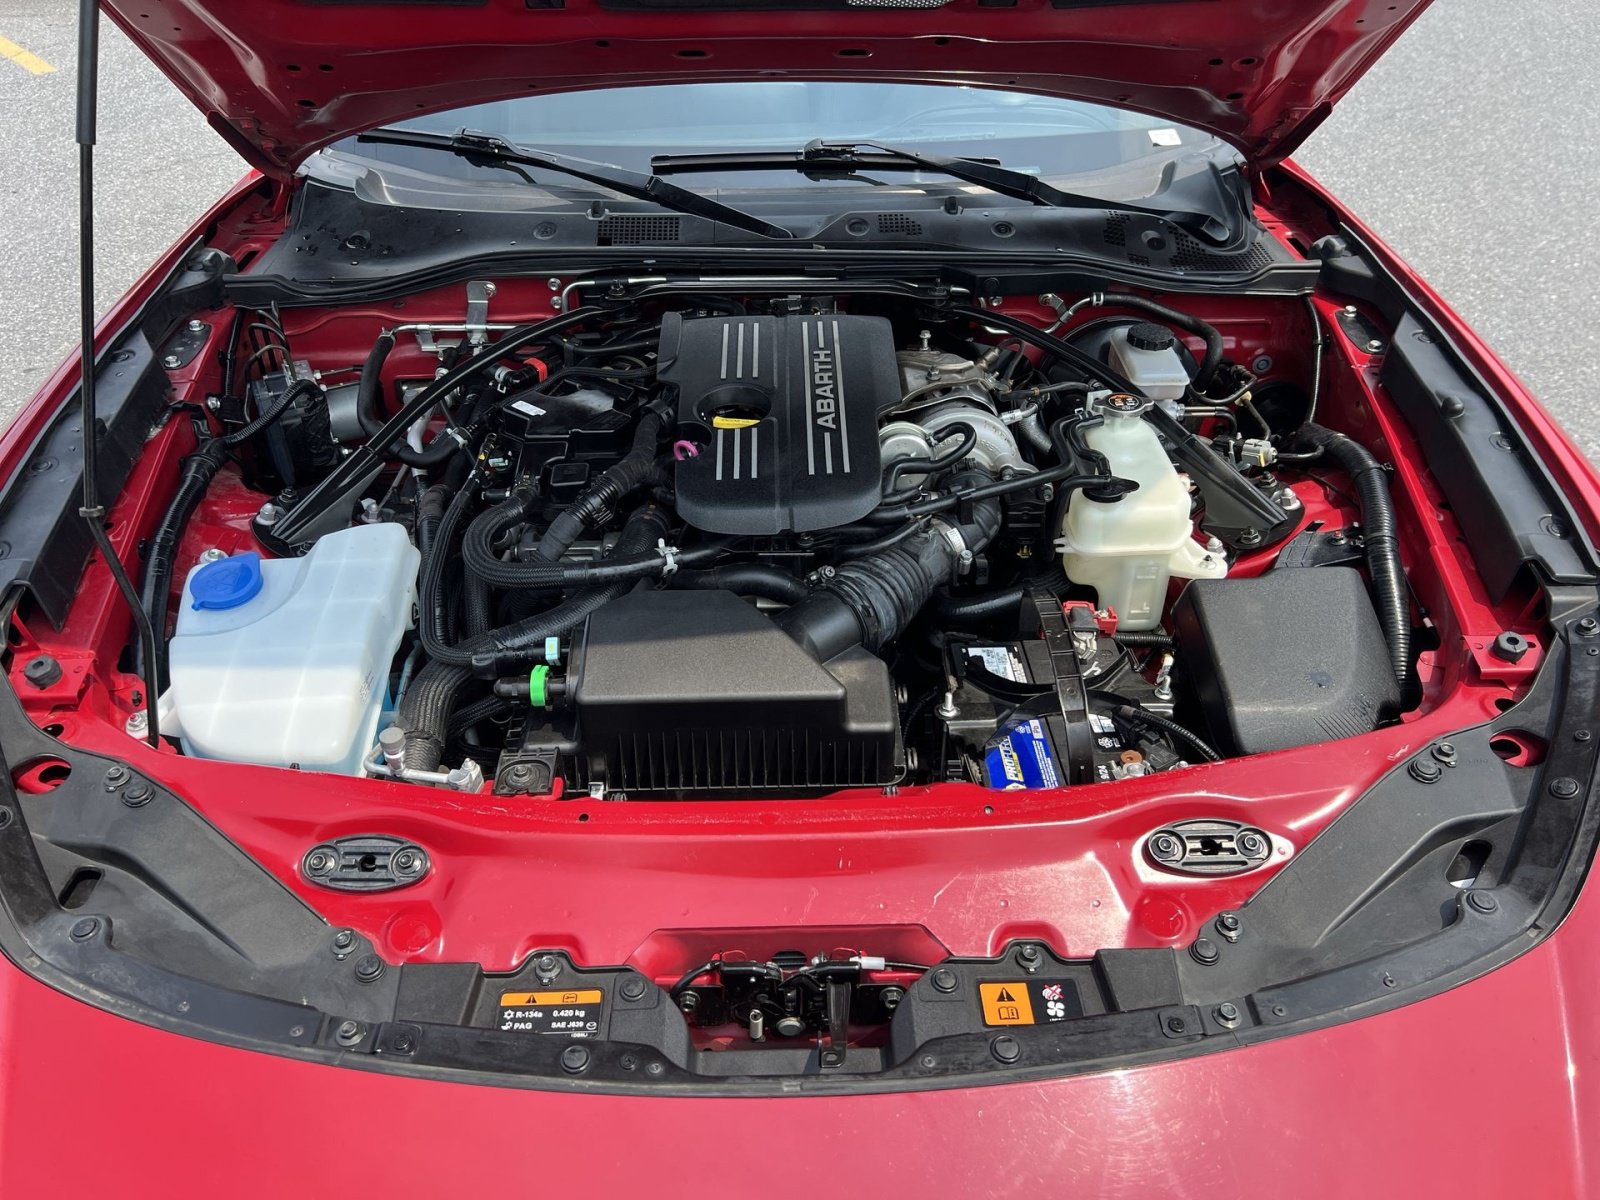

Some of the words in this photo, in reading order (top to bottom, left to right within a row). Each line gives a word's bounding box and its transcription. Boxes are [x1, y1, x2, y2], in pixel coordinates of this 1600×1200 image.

[813, 350, 836, 429] ABARTH
[1033, 725, 1041, 734] Pb
[552, 1009, 574, 1018] 0.420
[575, 1009, 586, 1018] kg
[513, 1022, 532, 1030] PAG
